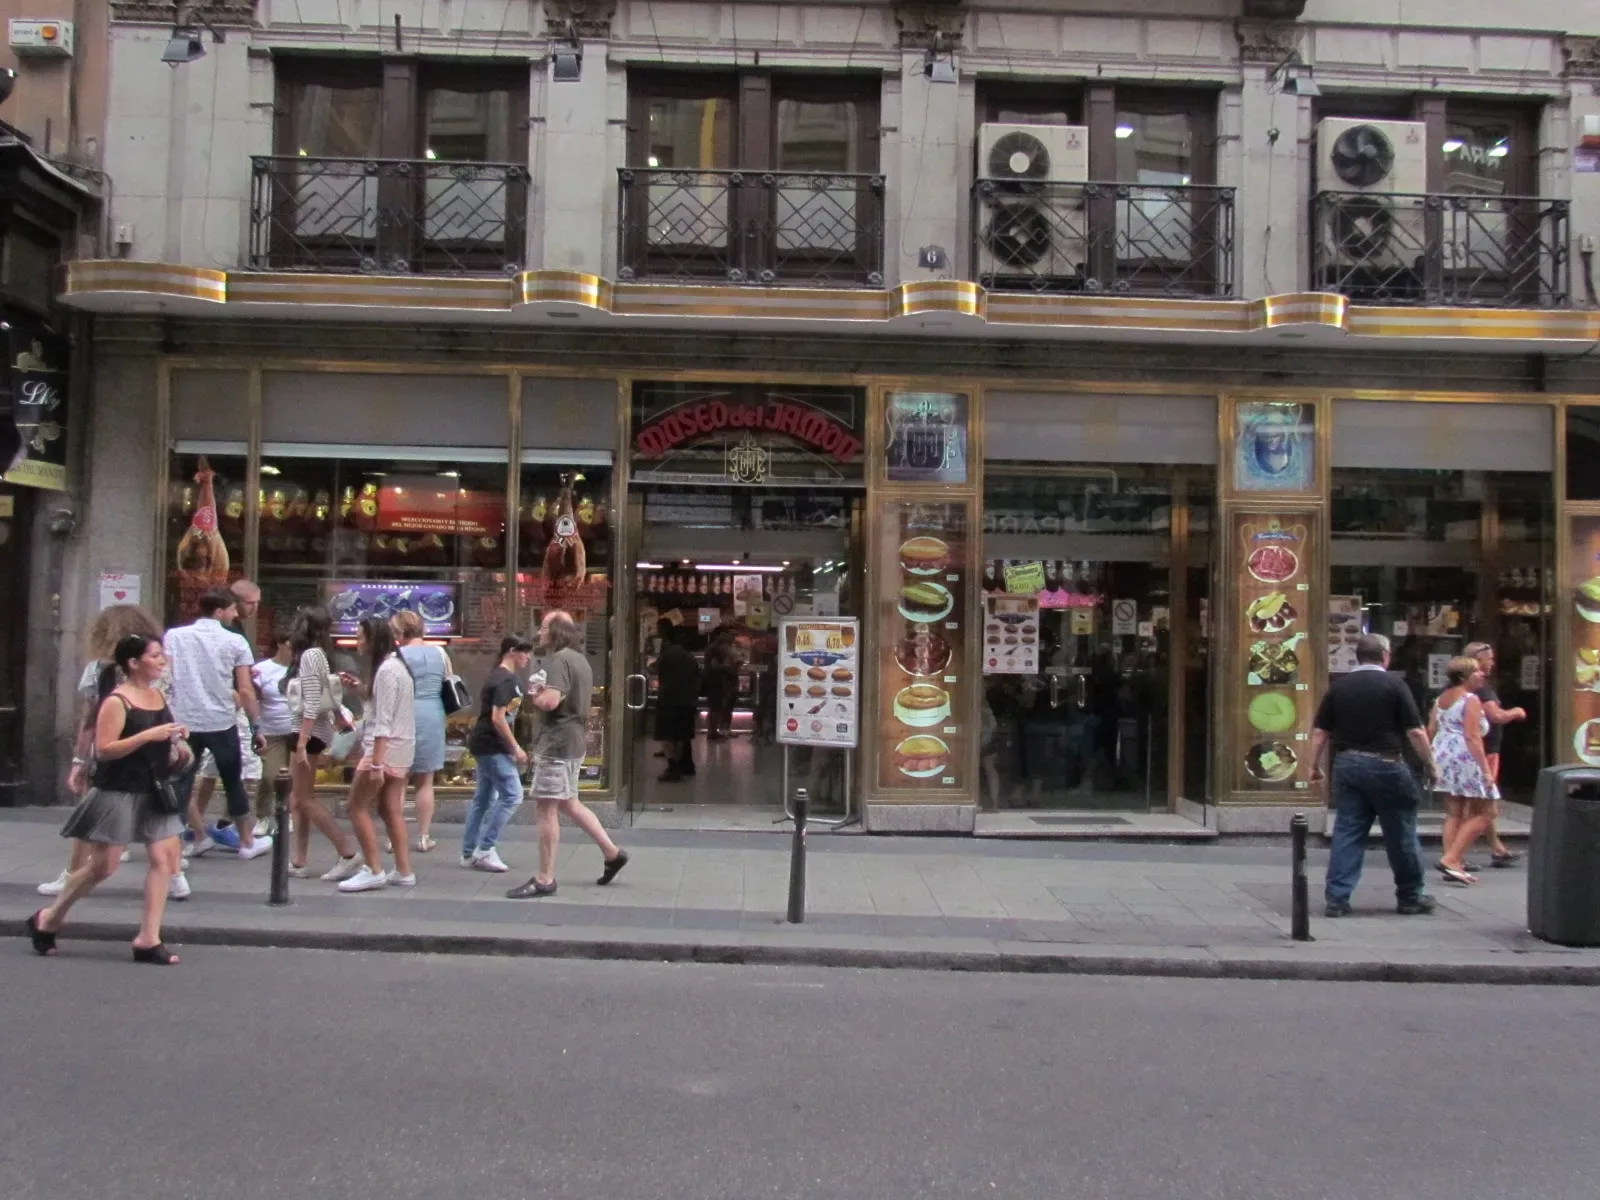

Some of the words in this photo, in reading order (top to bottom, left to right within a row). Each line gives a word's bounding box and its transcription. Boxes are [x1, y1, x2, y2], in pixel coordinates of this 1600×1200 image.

[927, 250, 937, 264] 6
[636, 400, 728, 455] MUSEO
[729, 404, 763, 427] del
[765, 400, 860, 463] JAMON
